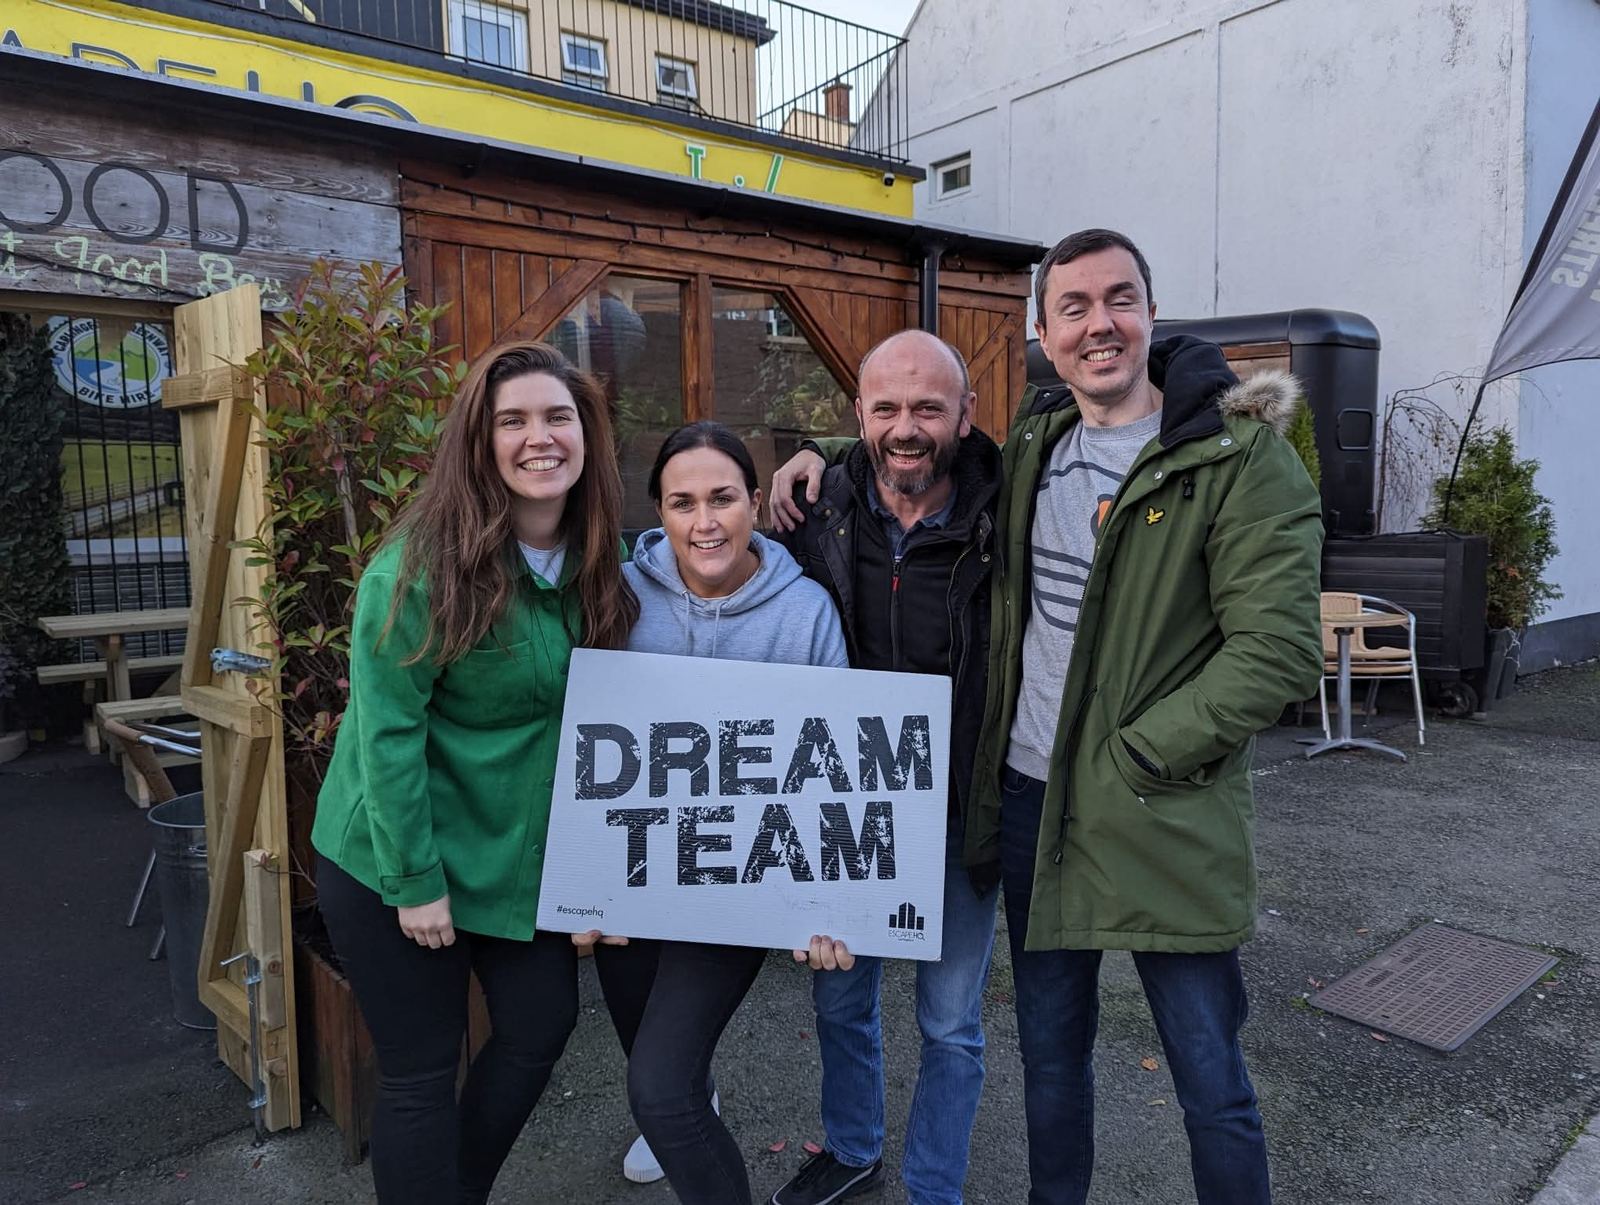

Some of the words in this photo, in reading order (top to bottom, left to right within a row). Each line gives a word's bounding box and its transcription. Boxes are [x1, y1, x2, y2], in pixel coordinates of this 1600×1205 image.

[575, 715, 933, 800] DREAM
[606, 801, 896, 887] TEAM
[556, 904, 604, 919] #escapehq
